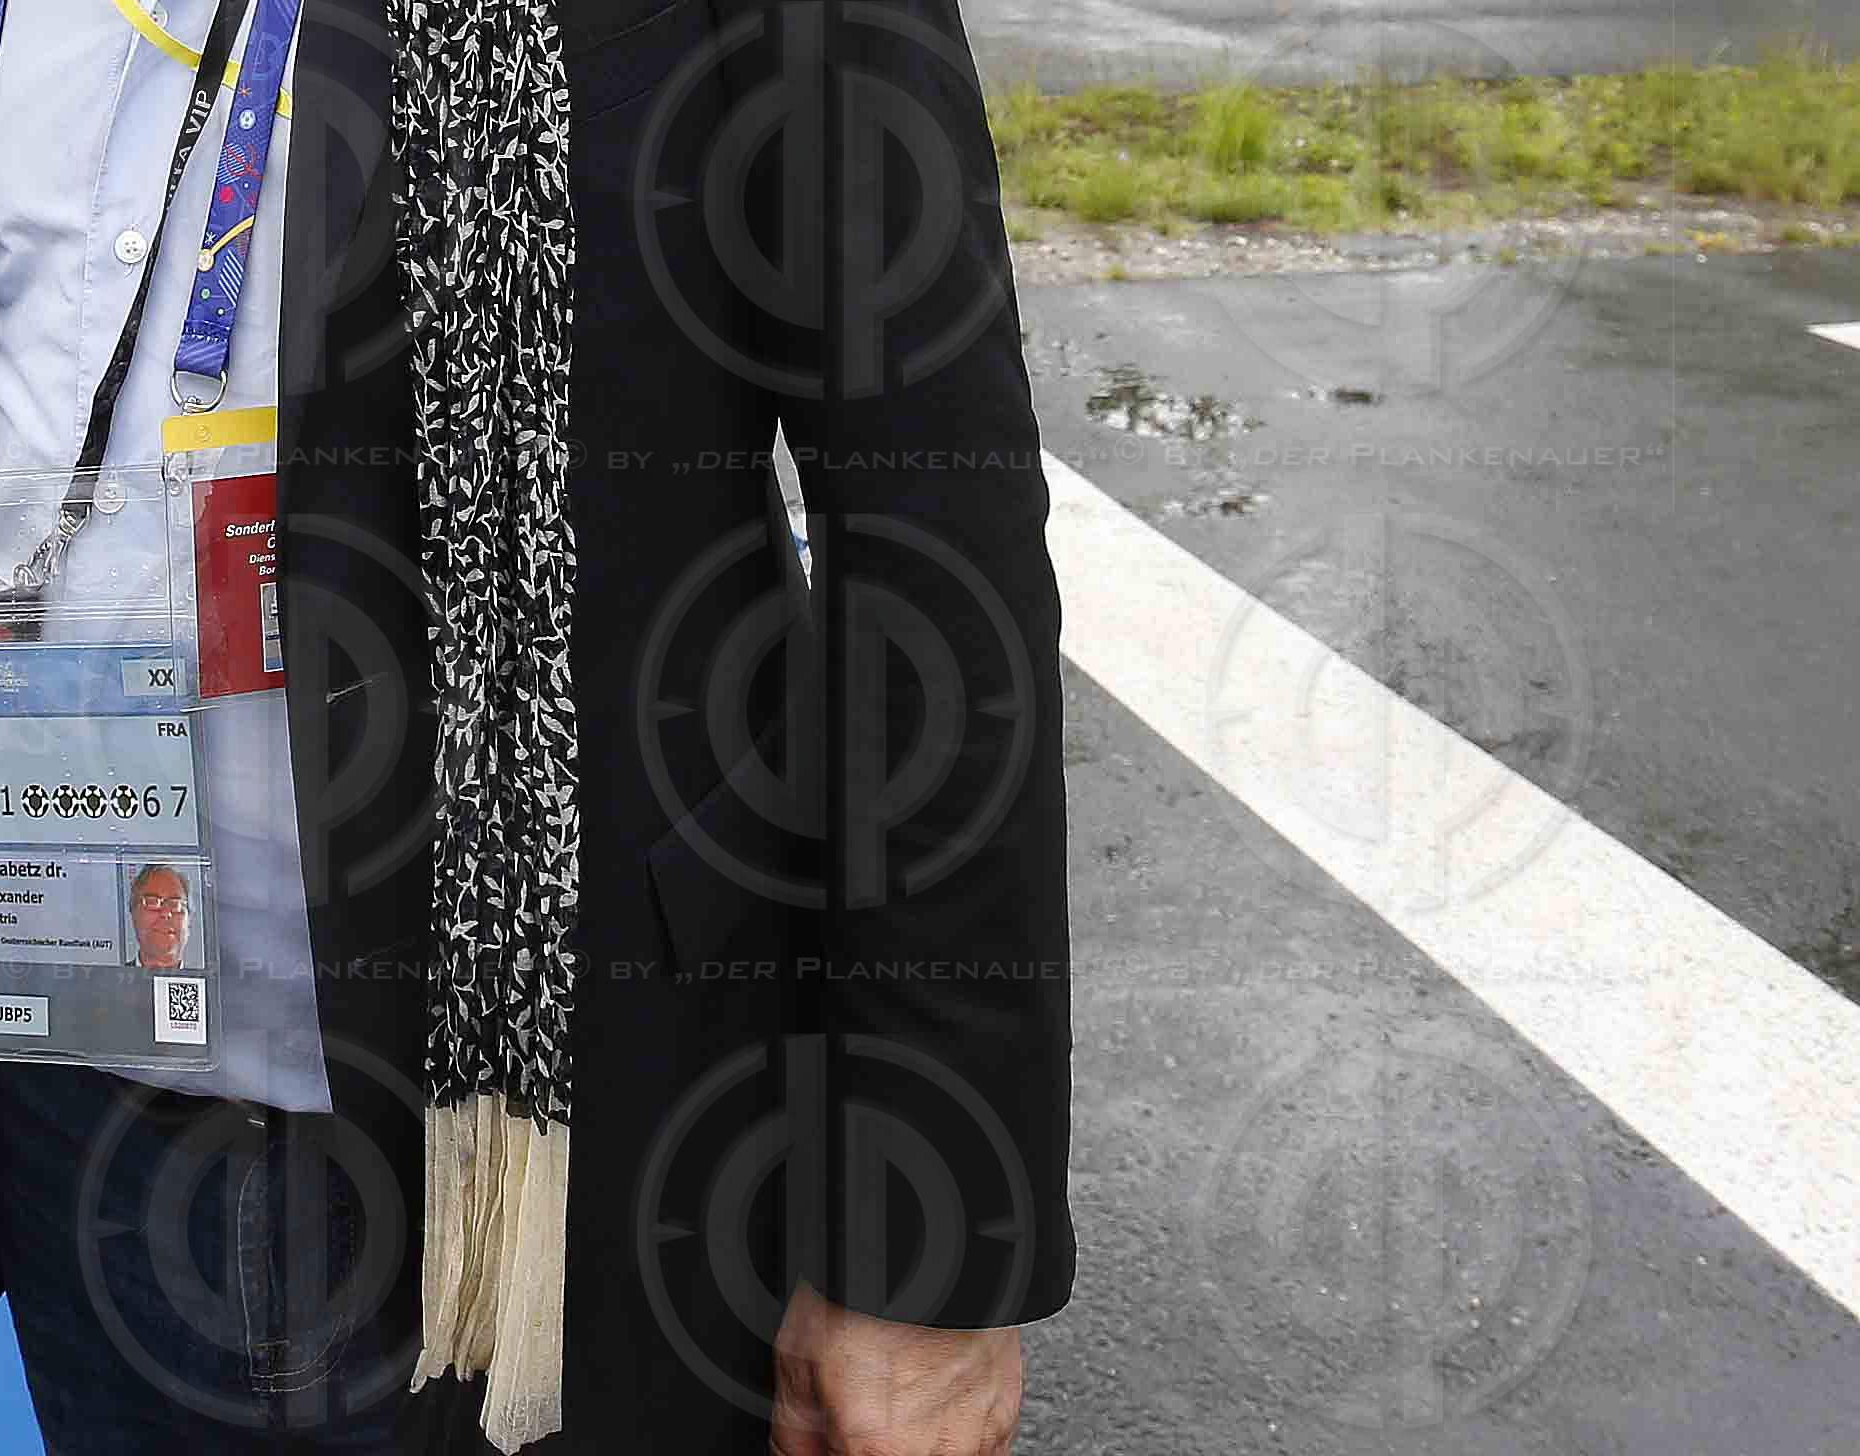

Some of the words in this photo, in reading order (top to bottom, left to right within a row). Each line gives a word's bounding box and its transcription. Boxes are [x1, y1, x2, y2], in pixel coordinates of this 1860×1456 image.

[185, 89, 212, 135] VIP
[148, 667, 174, 687] XX
[157, 723, 188, 737] FRA
[46, 861, 67, 878] dr.
